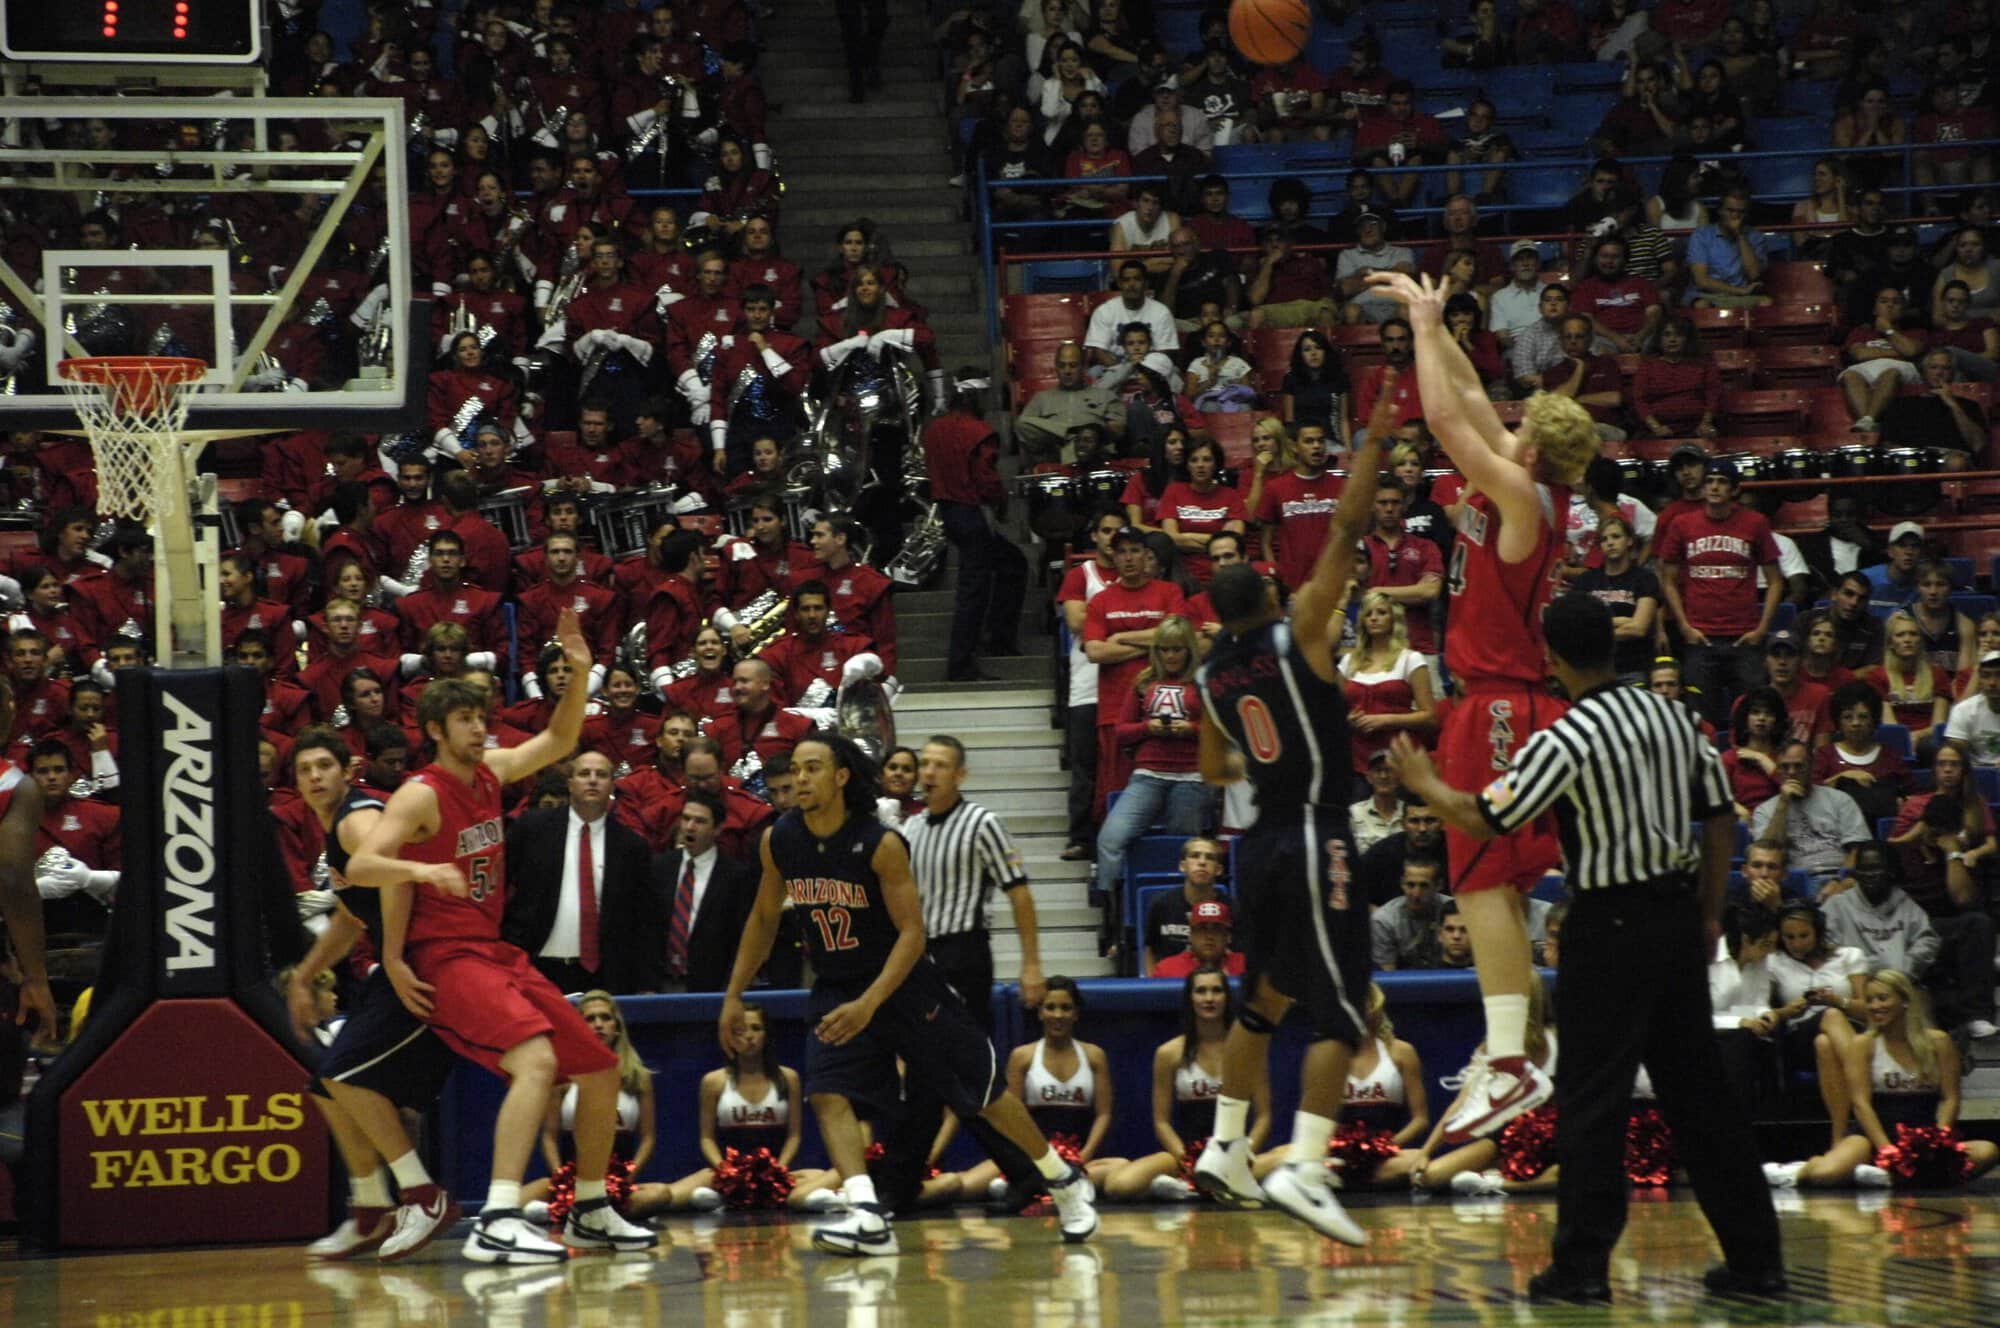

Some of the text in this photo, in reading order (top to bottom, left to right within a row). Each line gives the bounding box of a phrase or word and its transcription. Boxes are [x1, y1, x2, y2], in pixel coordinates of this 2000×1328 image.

[1687, 535, 1751, 559] ARIZONA
[1148, 685, 1187, 719] A
[1236, 694, 1283, 764] 0
[1488, 699, 1515, 771] CATS
[161, 689, 216, 972] ARIZONA
[784, 877, 870, 909] ARIZONA
[810, 906, 860, 952] 12
[81, 1092, 305, 1138] WELLS
[89, 1143, 302, 1190] FARGO
